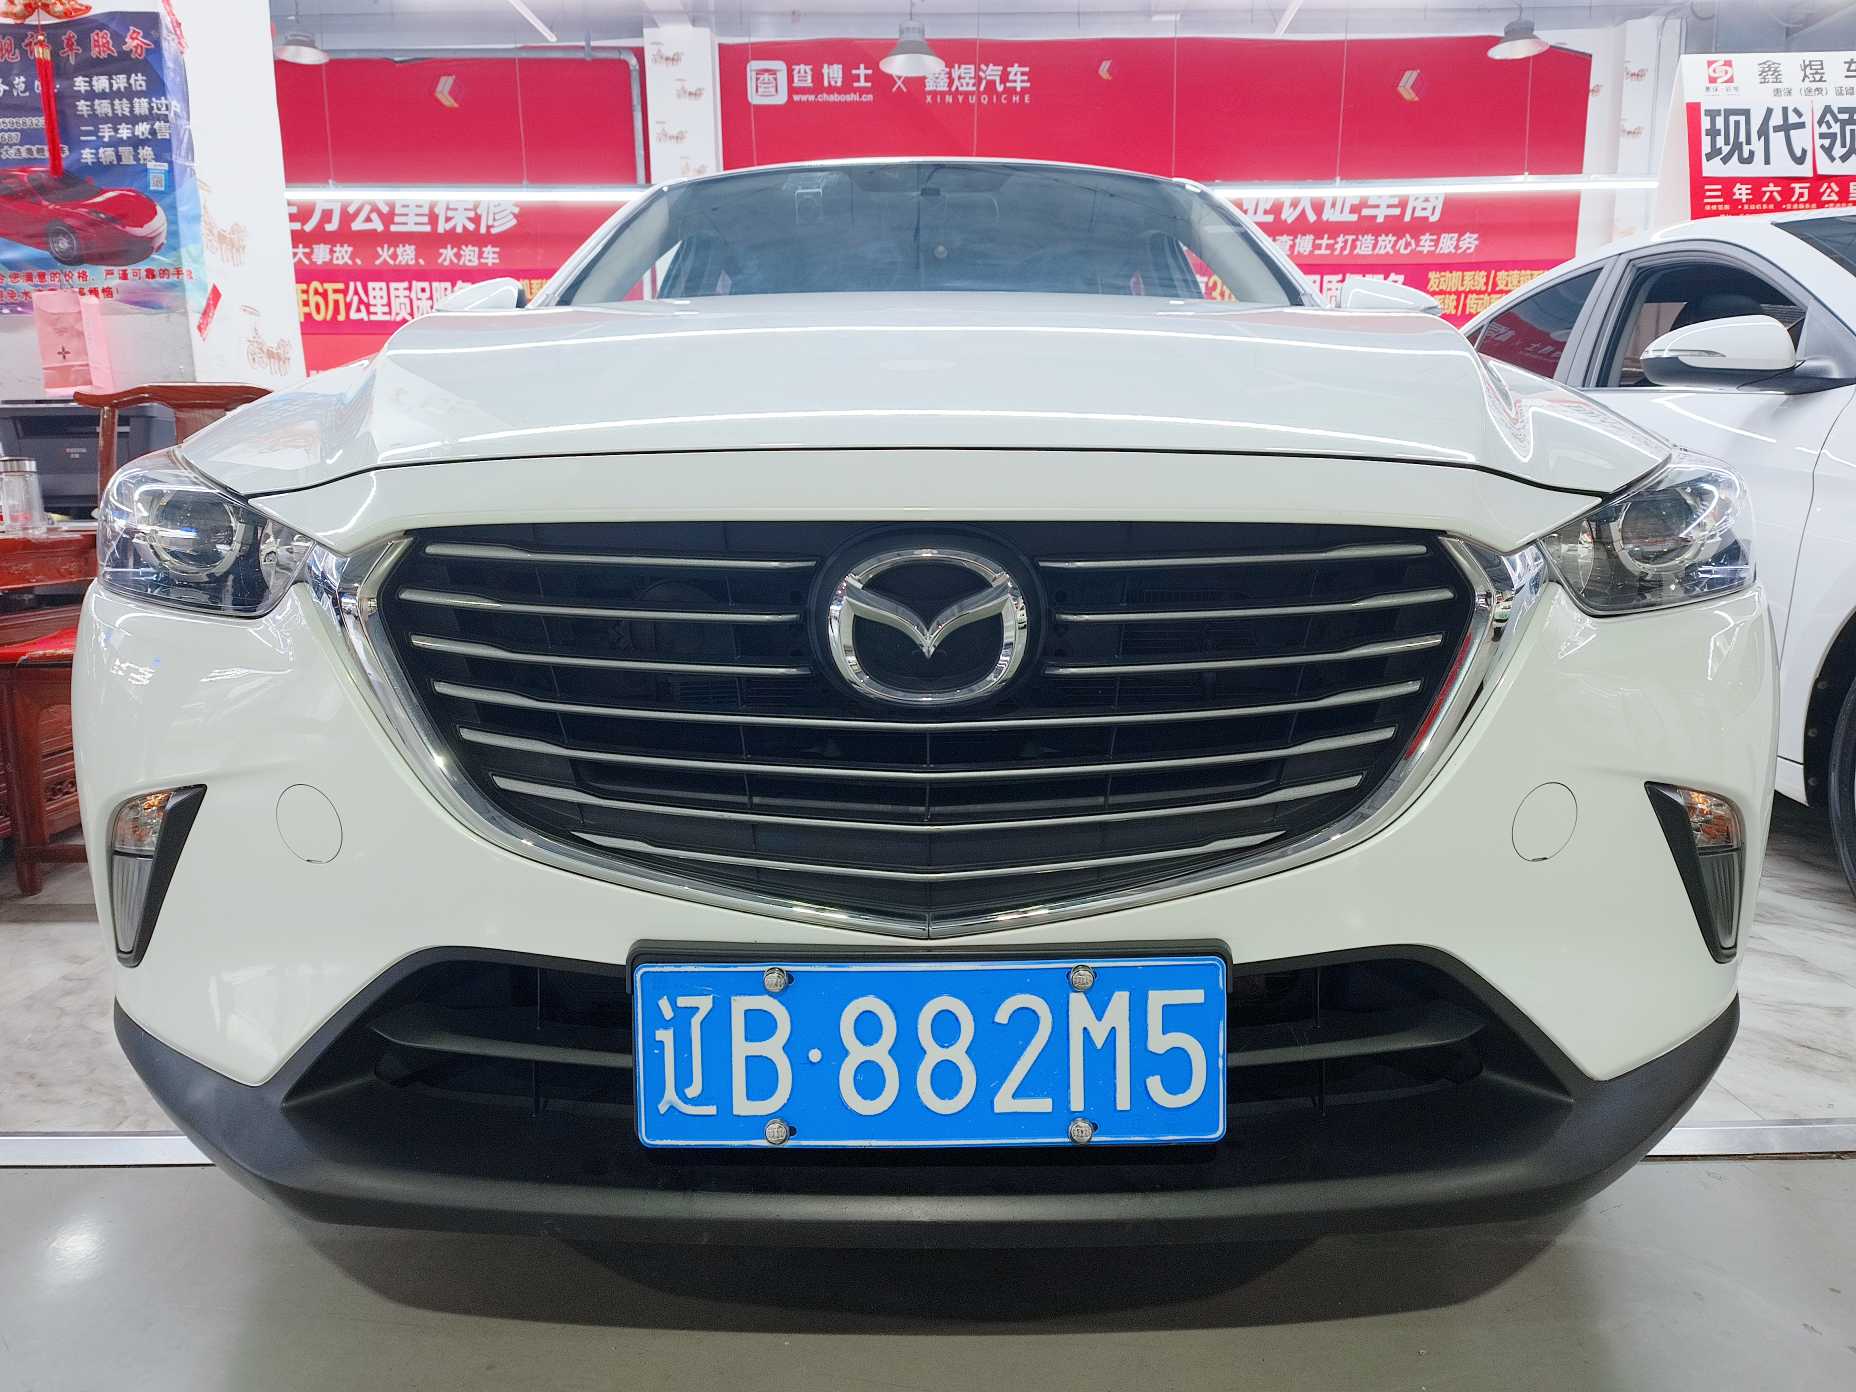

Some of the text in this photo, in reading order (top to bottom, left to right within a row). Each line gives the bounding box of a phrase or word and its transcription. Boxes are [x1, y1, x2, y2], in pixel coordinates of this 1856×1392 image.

[73, 73, 147, 94] 车辆评估
[792, 63, 873, 88] 查博士
[925, 63, 1031, 92] 鑫煜汽车
[792, 93, 874, 103] www.chaboshi.cn
[1704, 105, 1808, 167] 现代
[1703, 182, 1856, 204] 三年六万公
[655, 988, 1208, 1116] 辽B·882M5
